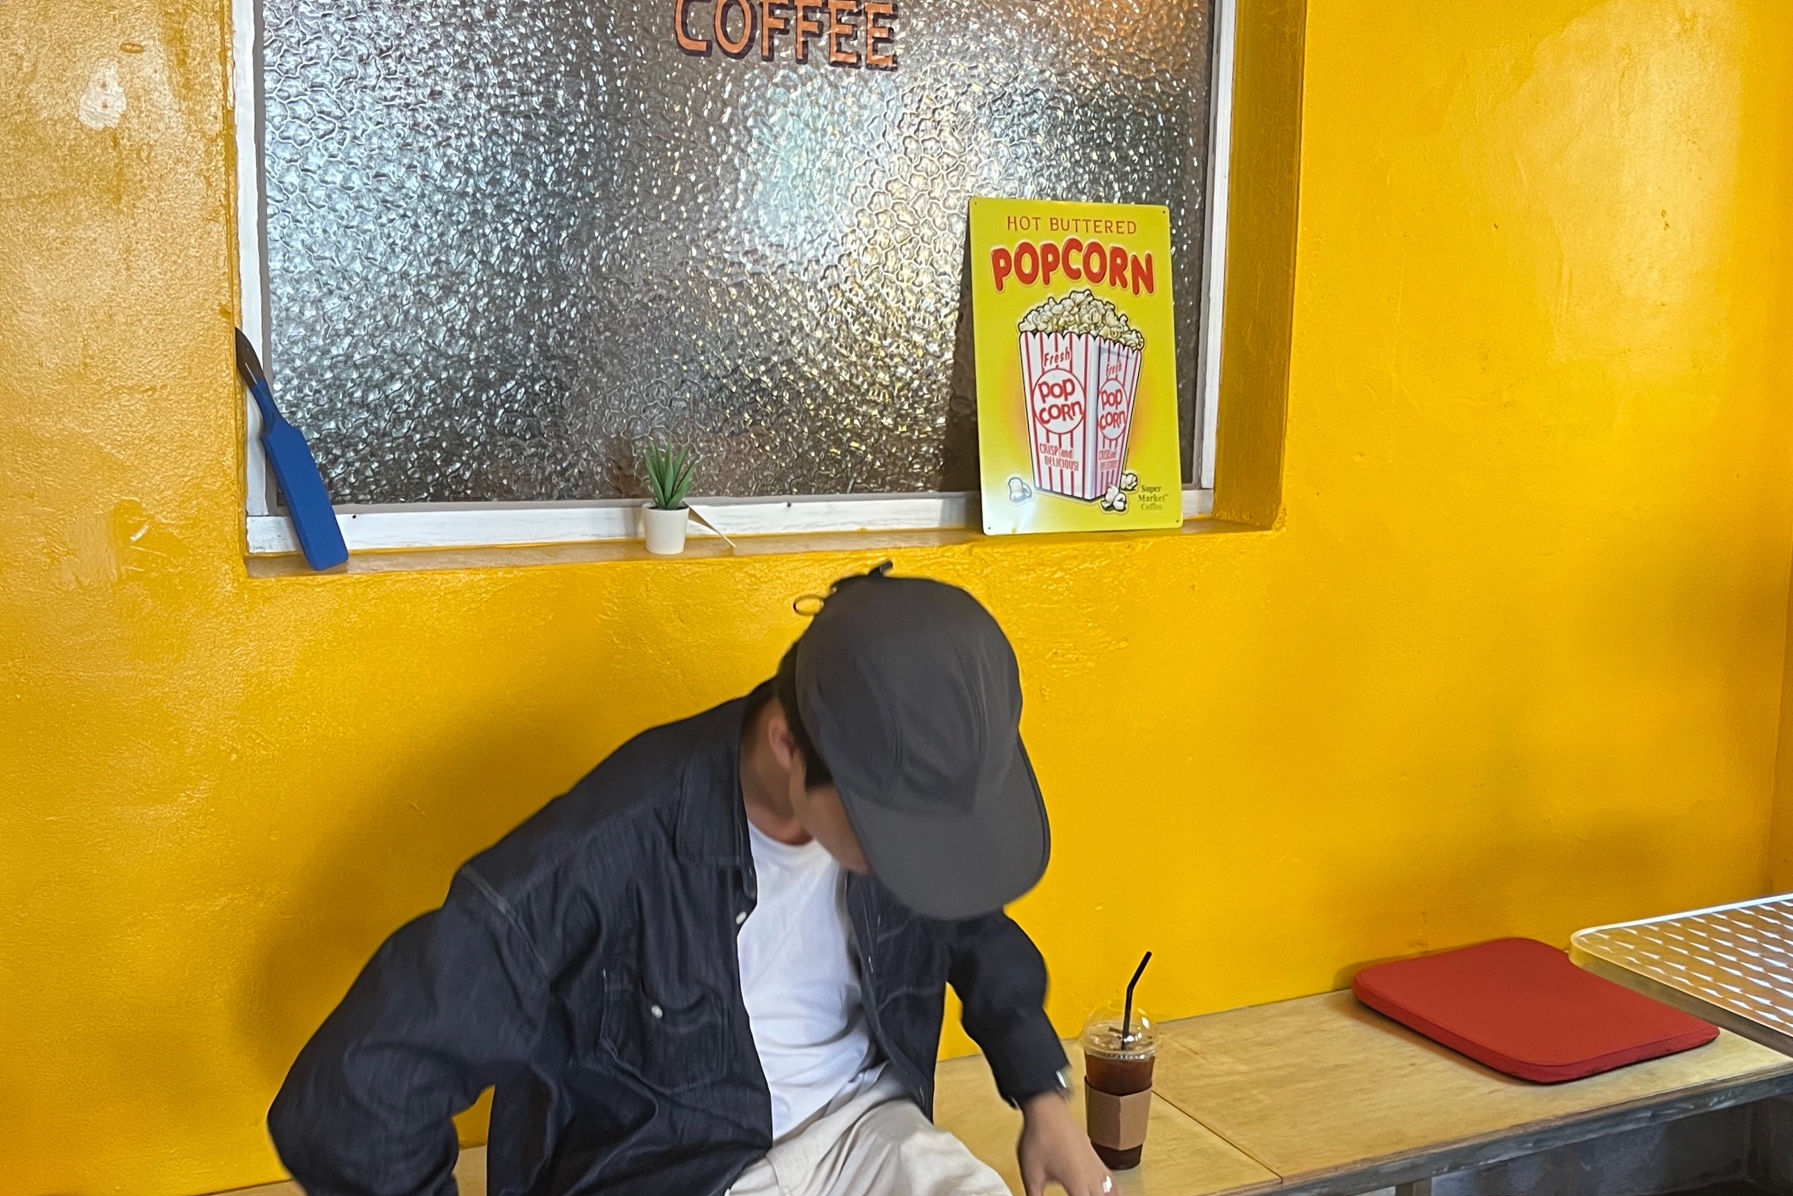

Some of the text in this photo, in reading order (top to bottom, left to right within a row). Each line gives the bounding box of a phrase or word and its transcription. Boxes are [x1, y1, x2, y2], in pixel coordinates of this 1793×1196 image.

[674, 0, 897, 70] COFFEE
[1007, 215, 1137, 235] HOT BUTTERED
[991, 238, 1156, 296] POPCORN
[1044, 347, 1071, 367] Fresh
[1039, 443, 1059, 455] CRISP
[1141, 485, 1162, 493] Super
[1141, 503, 1163, 511] Coffee
